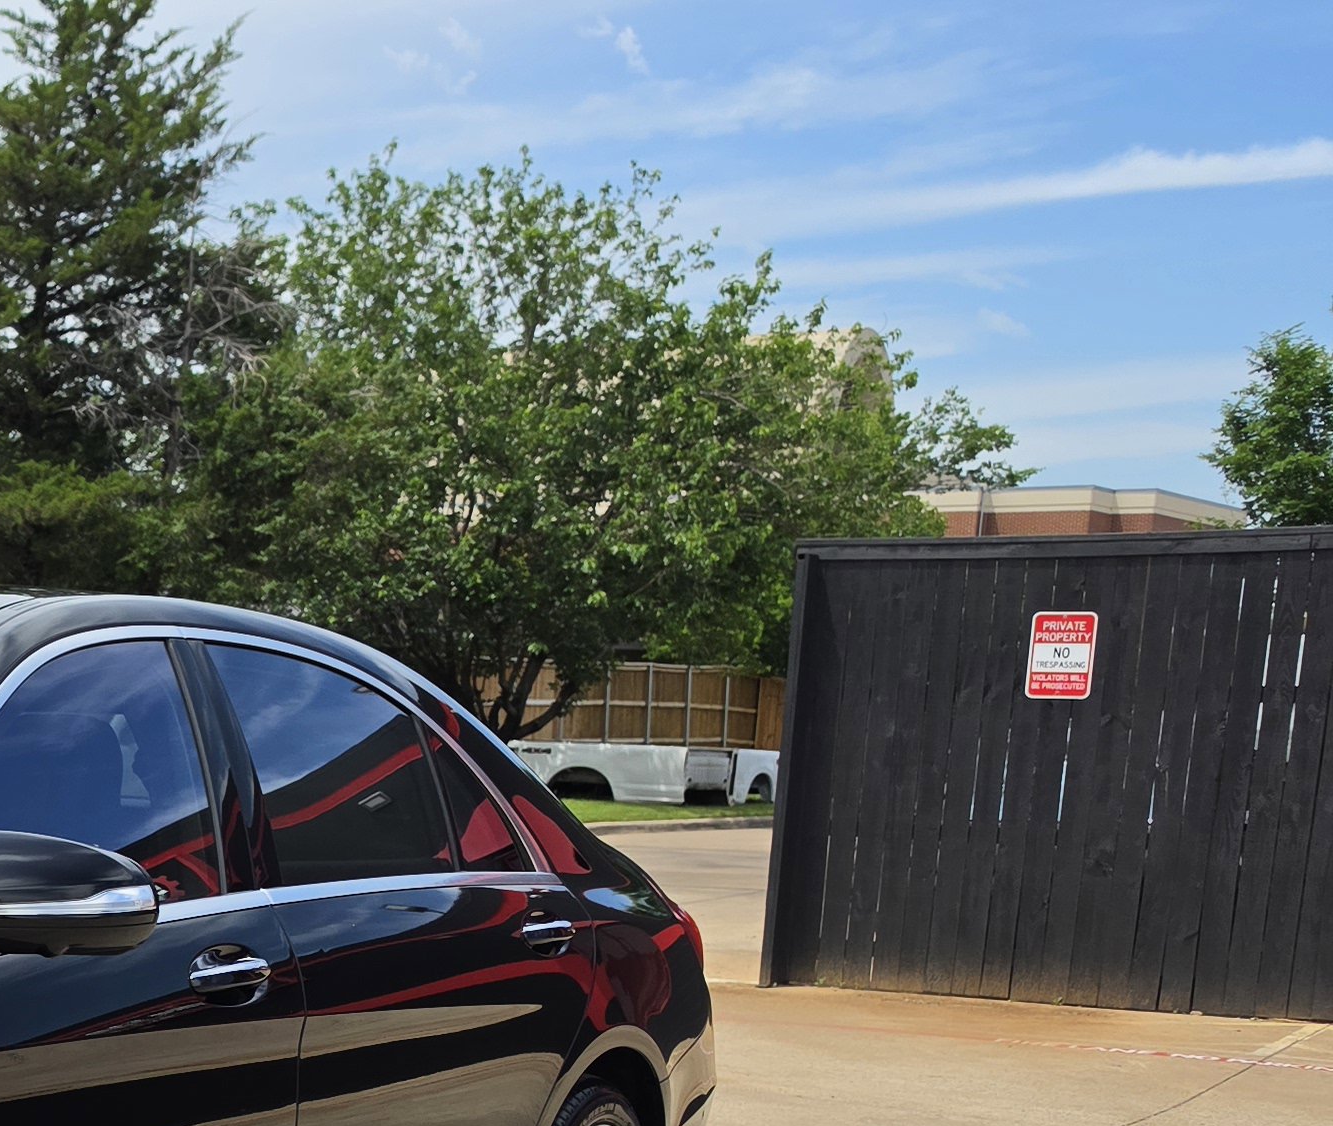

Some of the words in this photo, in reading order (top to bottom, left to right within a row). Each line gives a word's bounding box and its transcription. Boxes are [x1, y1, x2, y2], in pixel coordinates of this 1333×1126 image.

[1042, 620, 1087, 631] PRIVATE
[1035, 632, 1092, 642] PROPERTY
[1053, 647, 1070, 659] NO
[1035, 661, 1086, 669] TRESPASSING
[1032, 674, 1069, 682] VIOLATORS
[1070, 674, 1086, 682] WILL
[1042, 682, 1085, 690] PROSECUTED
